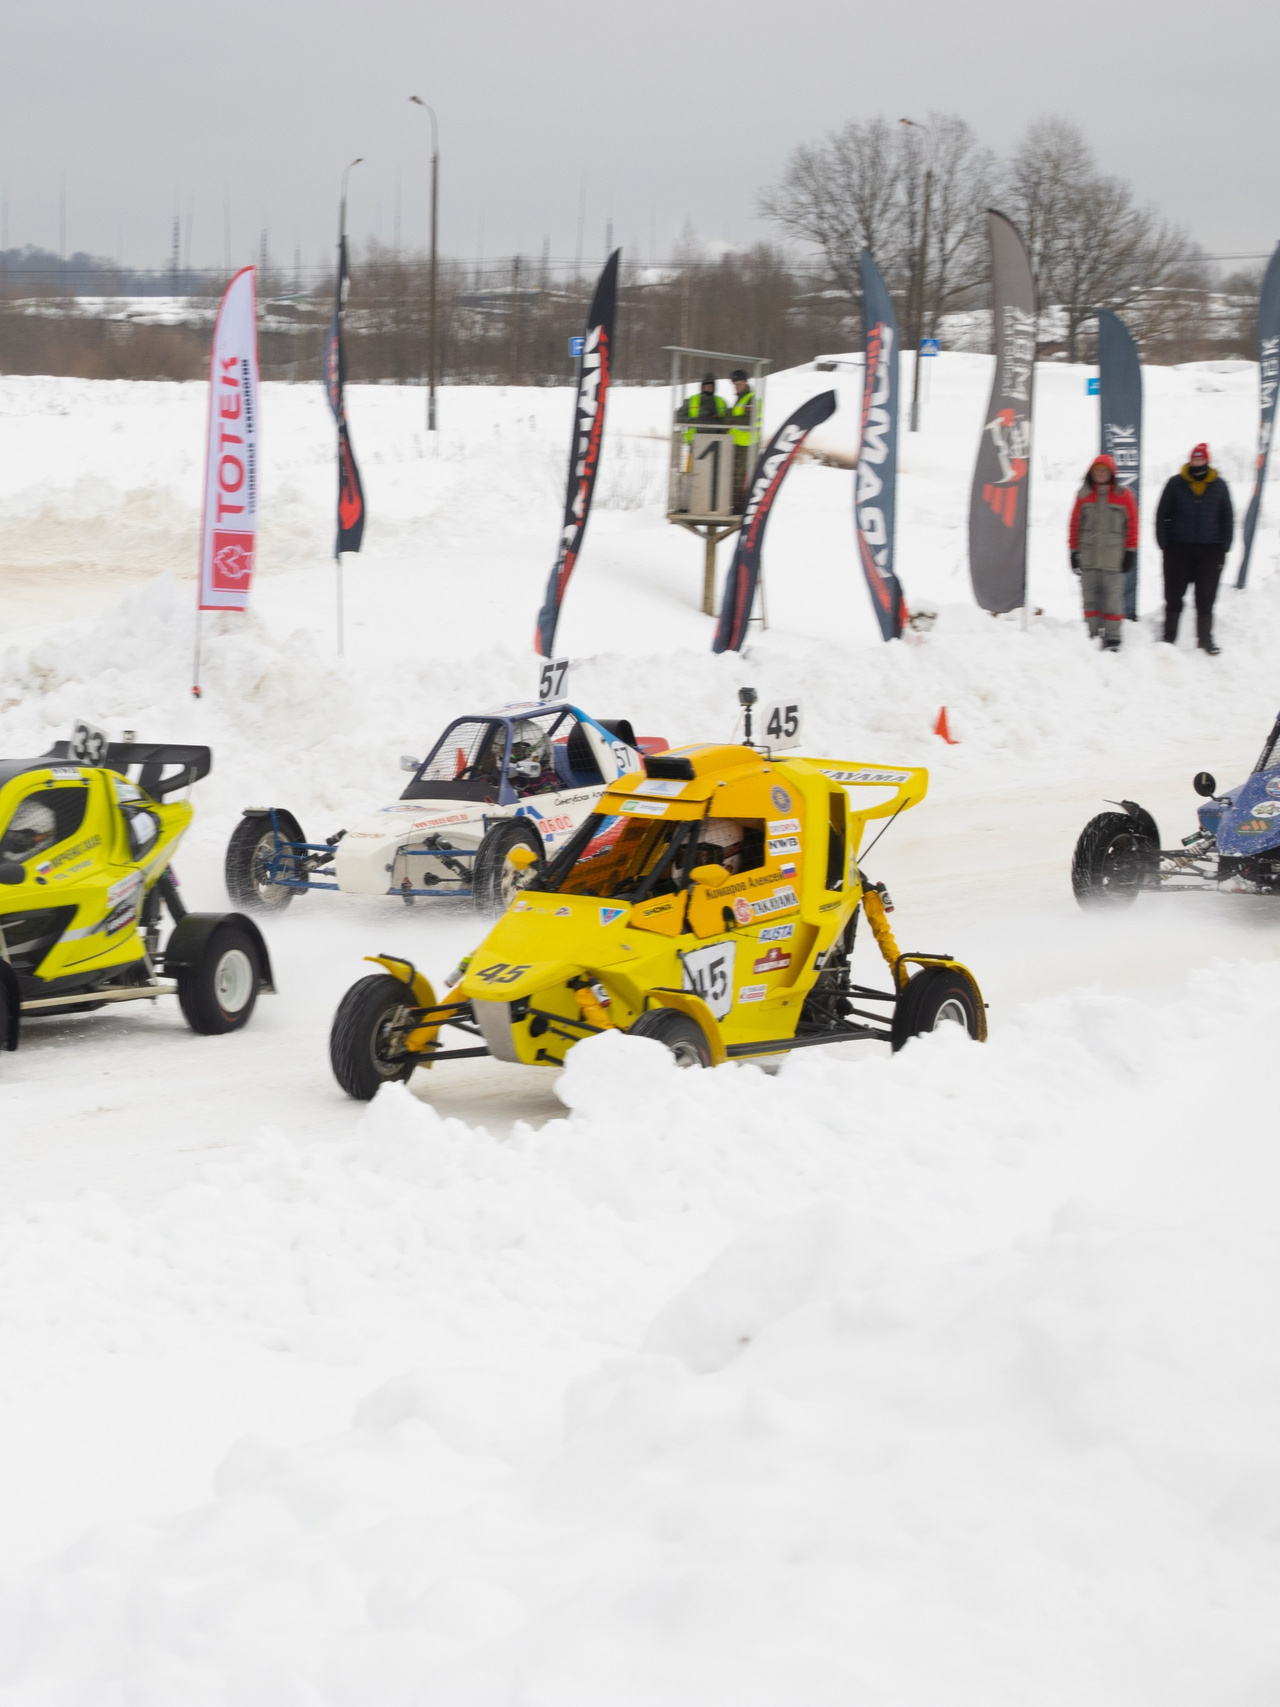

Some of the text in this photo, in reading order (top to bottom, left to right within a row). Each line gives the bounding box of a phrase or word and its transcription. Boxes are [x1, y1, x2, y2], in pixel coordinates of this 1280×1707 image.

[216, 356, 246, 524] TOTEK
[697, 441, 721, 513] 1
[539, 661, 569, 699] 57
[767, 705, 799, 739] 45
[75, 725, 103, 766] 33
[614, 747, 632, 769] 57
[769, 837, 799, 850] NWB
[705, 881, 747, 901] Комаров
[751, 893, 799, 916] TAKAYAMA
[760, 924, 793, 941] RUSTA
[476, 963, 532, 984] 45
